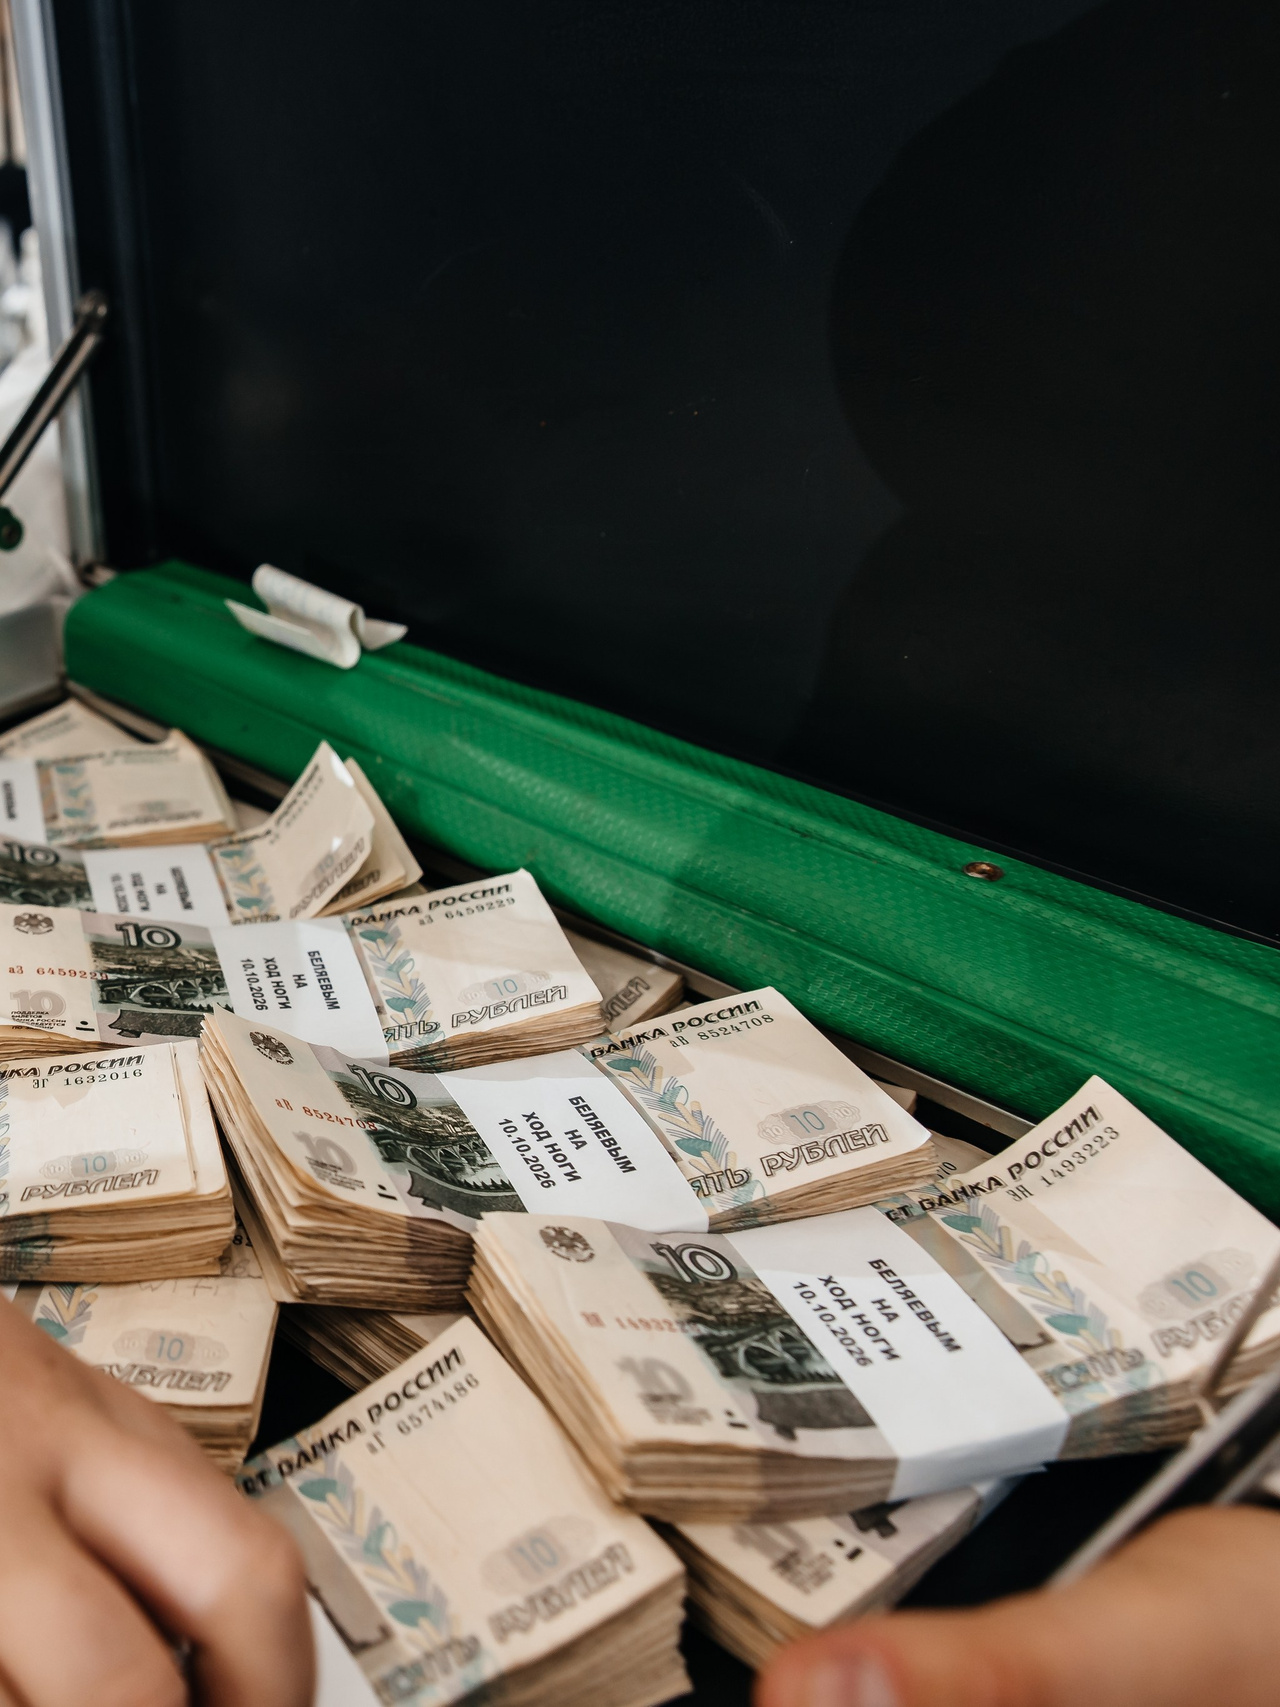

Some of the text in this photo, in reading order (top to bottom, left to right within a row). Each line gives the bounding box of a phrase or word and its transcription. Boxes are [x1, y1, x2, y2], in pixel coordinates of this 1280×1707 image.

[2, 840, 61, 867] 10
[350, 883, 512, 926] БАНКА РОССИИ
[445, 897, 516, 920] 6459229
[115, 921, 182, 950] 10
[36, 967, 109, 981] 6459229
[241, 958, 268, 1011] 10.10.2026
[263, 957, 292, 1010] ХОД НОГИ
[292, 974, 308, 989] НА
[307, 950, 340, 1010] БЕЛЯЕВЫМ
[492, 978, 518, 996] 10
[382, 985, 568, 1042] ЯТЬ РУБЛЕЙ
[590, 999, 763, 1058] БАНКА РОССИИ
[697, 1014, 775, 1041] 8524708
[47, 1054, 146, 1077] РОССИИ
[63, 1069, 143, 1086] 1632016
[345, 1062, 418, 1110] 10
[302, 1106, 378, 1132] 8524708
[564, 1129, 588, 1150] НА
[568, 1095, 637, 1174] БЕЛЯЕВЫМ
[789, 1110, 826, 1134] 10
[82, 1155, 108, 1174] 10
[498, 1118, 556, 1189] 10.10.2026
[521, 1111, 582, 1182] ХОД НОГИ
[687, 1167, 751, 1197] ЯТЬ
[760, 1123, 891, 1177] РУБЛЕЙ
[918, 1175, 1007, 1213] БАНКА
[1007, 1103, 1104, 1182] РОССИИ
[1039, 1126, 1121, 1188] 1493223
[20, 1169, 160, 1202] РУБЛЕЙ
[649, 1242, 738, 1285] 10
[868, 1258, 963, 1353] БЕЛЯЕВЫМ
[1171, 1270, 1218, 1302] 10
[793, 1281, 874, 1367] 10.10.2026
[817, 1275, 902, 1361] ХОД НОГИ
[871, 1298, 900, 1323] НА
[156, 1335, 185, 1362] 10
[277, 1419, 365, 1478] БАНКА
[367, 1347, 465, 1424] РОССИИ
[396, 1372, 480, 1435] 6574486
